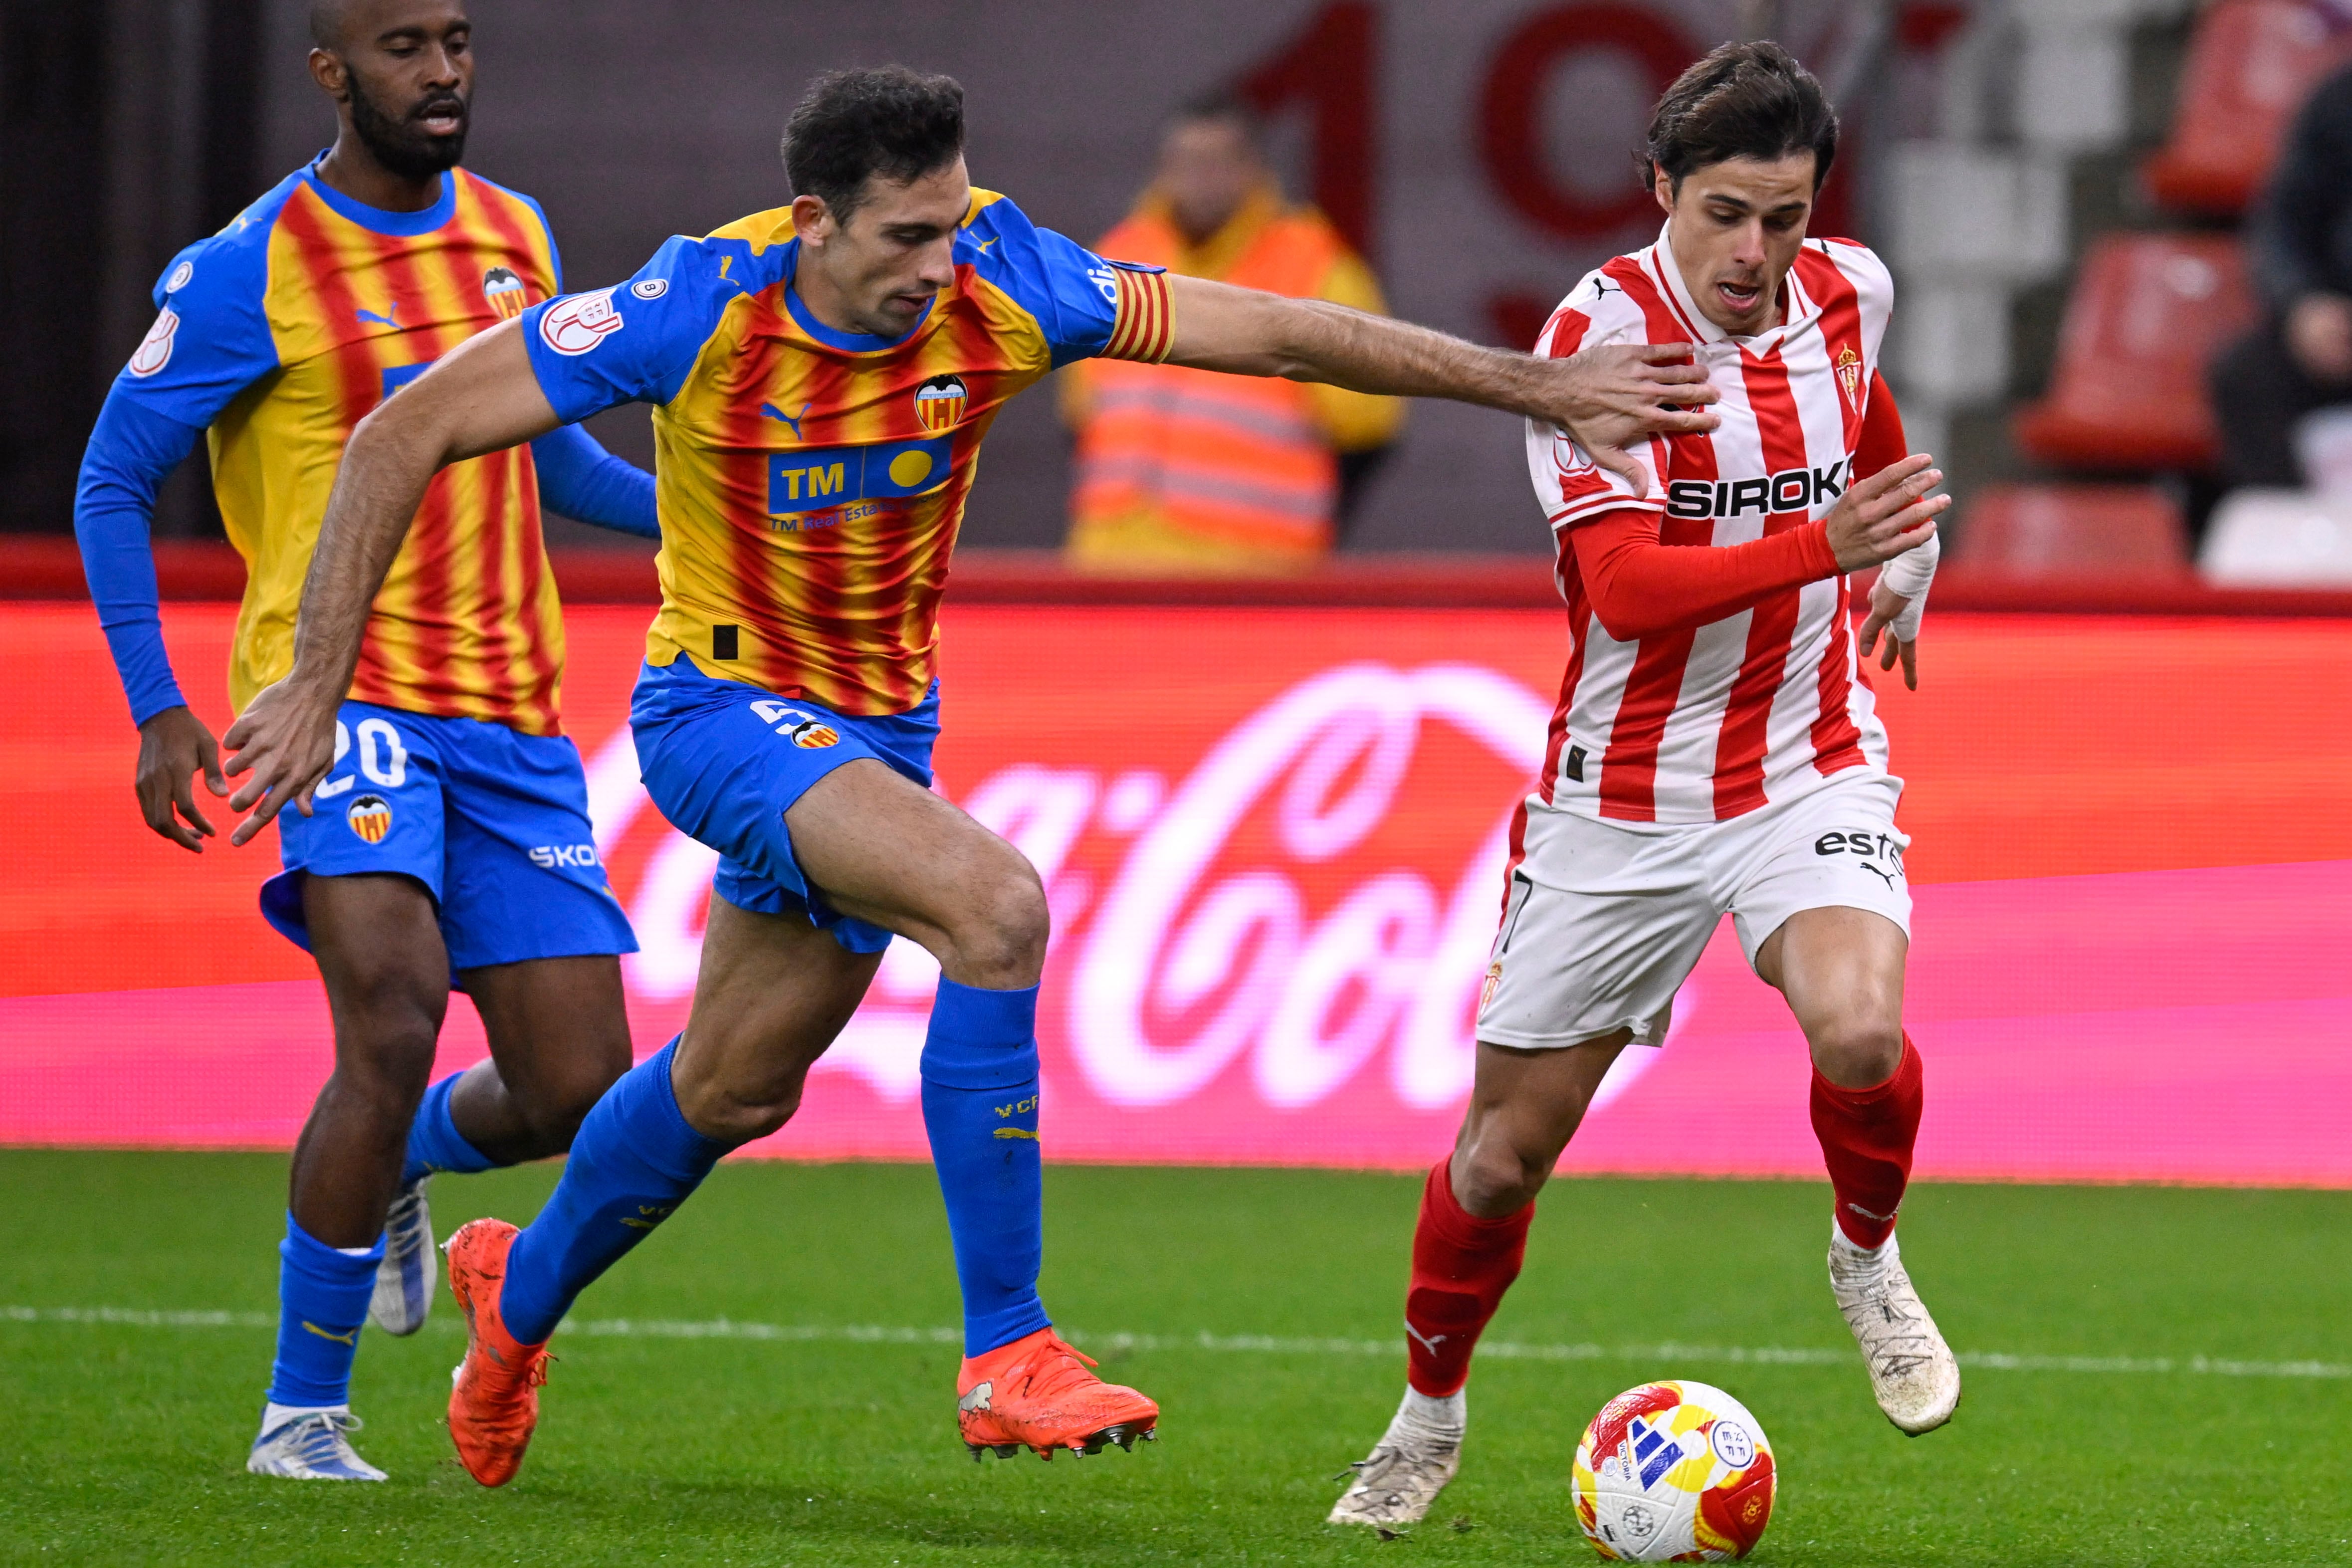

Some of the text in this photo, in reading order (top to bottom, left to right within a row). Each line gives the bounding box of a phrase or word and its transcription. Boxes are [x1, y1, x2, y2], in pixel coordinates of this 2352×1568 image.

[1087, 263, 1117, 304] di
[782, 462, 844, 500] TM
[1666, 457, 1853, 518] SIROK
[770, 502, 895, 531] TM Real Estate
[749, 700, 818, 735] 5
[315, 718, 408, 799] 20
[528, 844, 605, 869] SKO
[1501, 869, 1533, 954] 7
[995, 1095, 1038, 1118] VCF
[1619, 1441, 1632, 1481] VICTORIA
